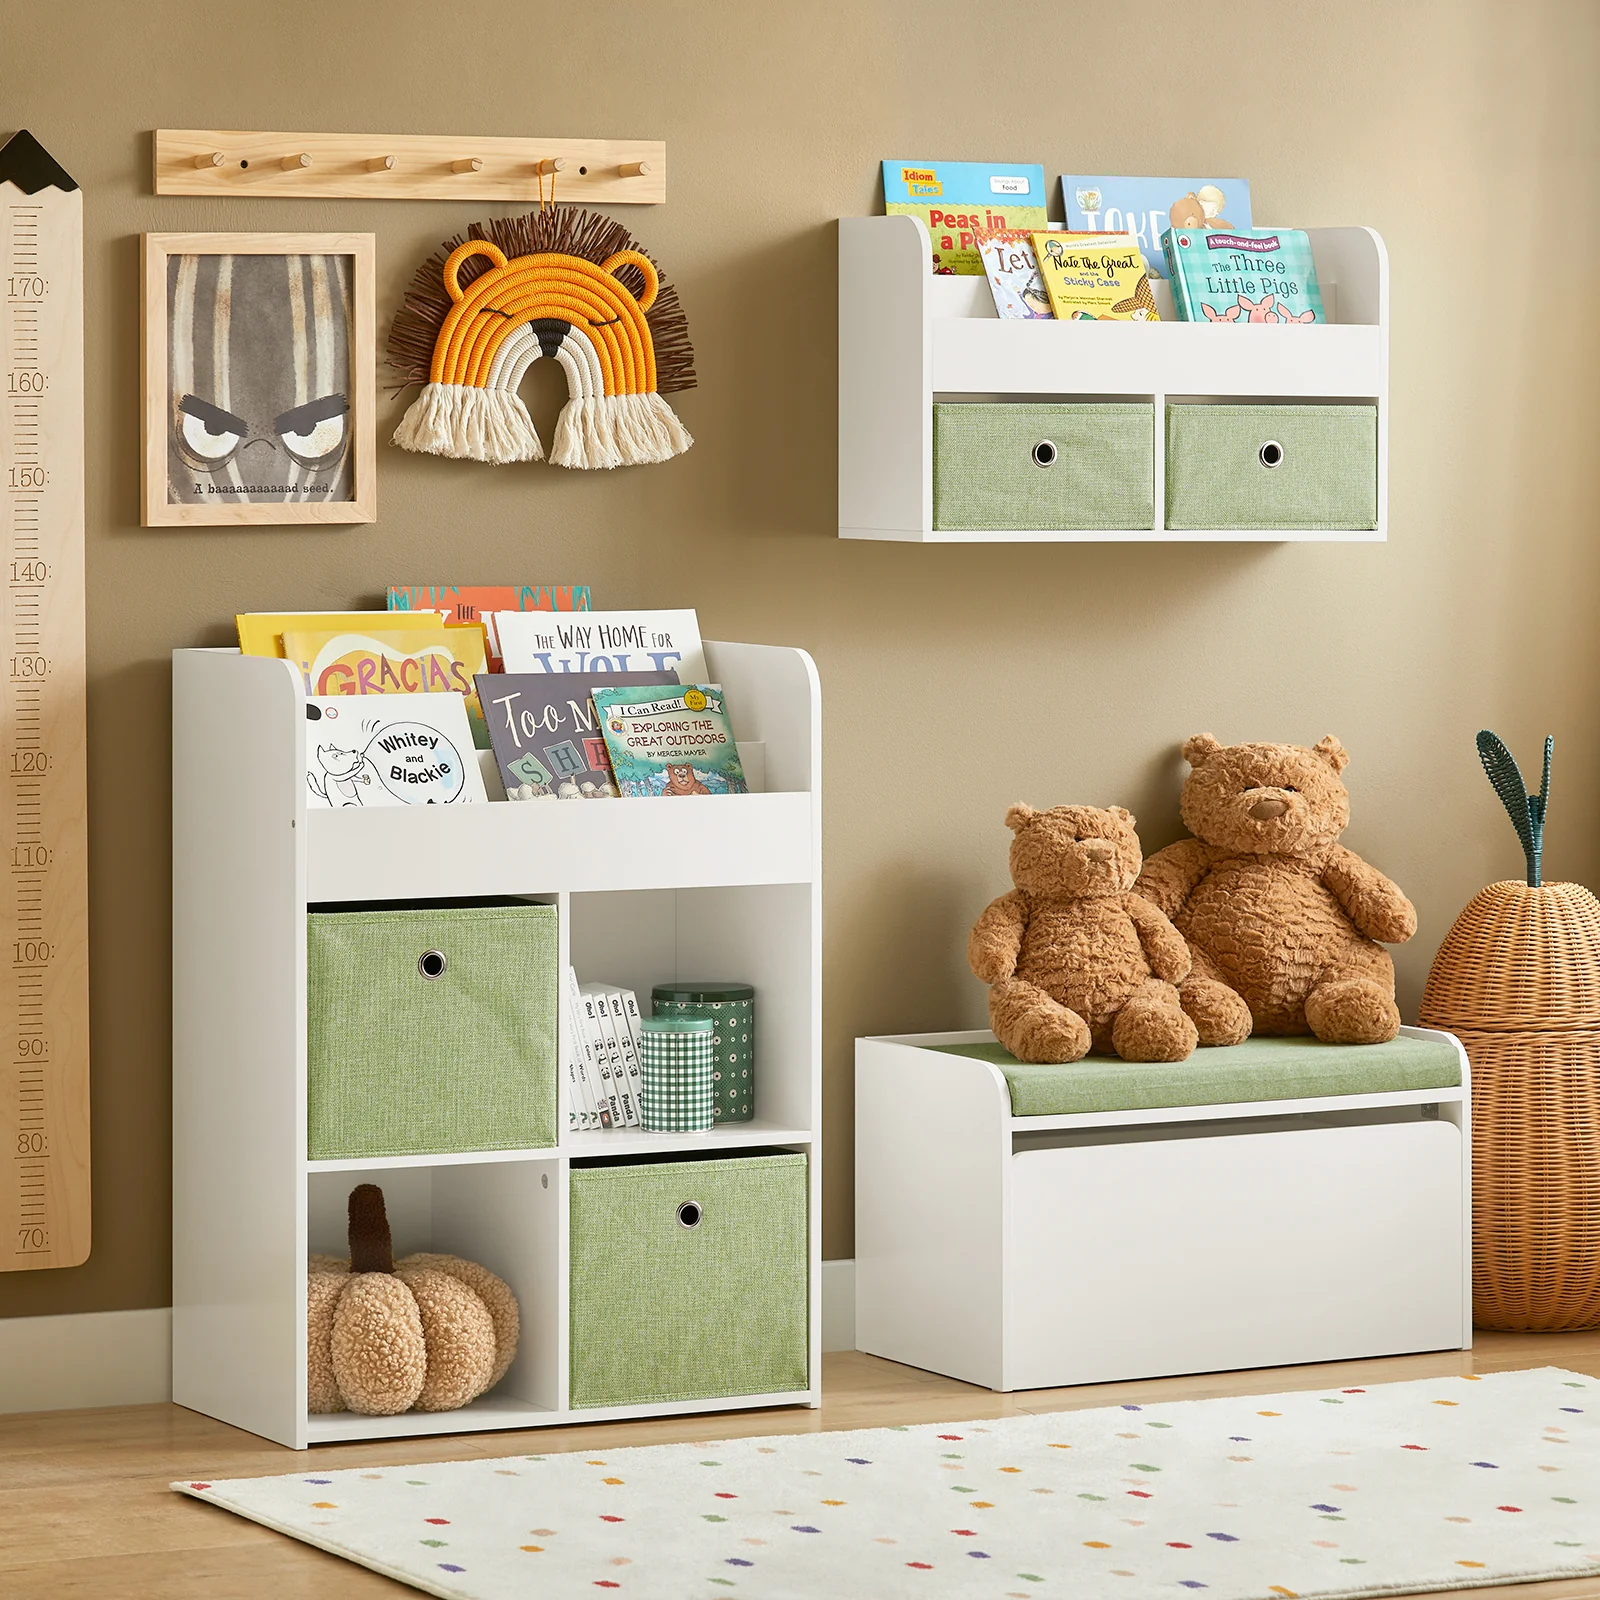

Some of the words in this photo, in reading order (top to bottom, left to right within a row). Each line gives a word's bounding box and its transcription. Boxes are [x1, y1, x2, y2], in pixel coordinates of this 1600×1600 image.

[904, 170, 933, 182] Idiom
[912, 184, 939, 194] Tales
[929, 210, 980, 229] Peas
[986, 210, 1006, 229] in
[940, 235, 953, 250] a
[1263, 240, 1278, 249] book
[994, 247, 1035, 274] Let
[1053, 255, 1080, 270] Nate
[1101, 254, 1139, 278] Great
[1212, 262, 1231, 272] The
[1230, 254, 1286, 274] Three
[1063, 277, 1095, 288] Sticky
[1096, 278, 1121, 287] Case
[1206, 277, 1256, 294] Little
[1260, 278, 1299, 299] Pigs
[193, 483, 203, 494] A
[303, 483, 334, 494] seed.
[456, 604, 476, 620] THE
[534, 634, 555, 649] THE
[556, 625, 592, 649] WAY
[598, 624, 649, 649] HOME
[651, 632, 673, 648] FOR
[620, 707, 625, 715] I
[627, 706, 650, 716] Can
[651, 700, 682, 712] Read!
[492, 692, 567, 748] Too
[632, 721, 690, 733] EXPLORING
[691, 720, 714, 731] THE
[378, 732, 439, 754] Whitey
[627, 736, 663, 747] GREAT
[669, 733, 727, 746] OUTDOORS
[405, 754, 424, 763] and
[390, 761, 451, 785] Blackie
[585, 1001, 596, 1019] Oho!
[598, 1000, 608, 1018] Oho!
[612, 999, 622, 1017] Oho!
[627, 999, 638, 1017] Oho!
[608, 1095, 620, 1122] Panda
[621, 1093, 633, 1120] Panda
